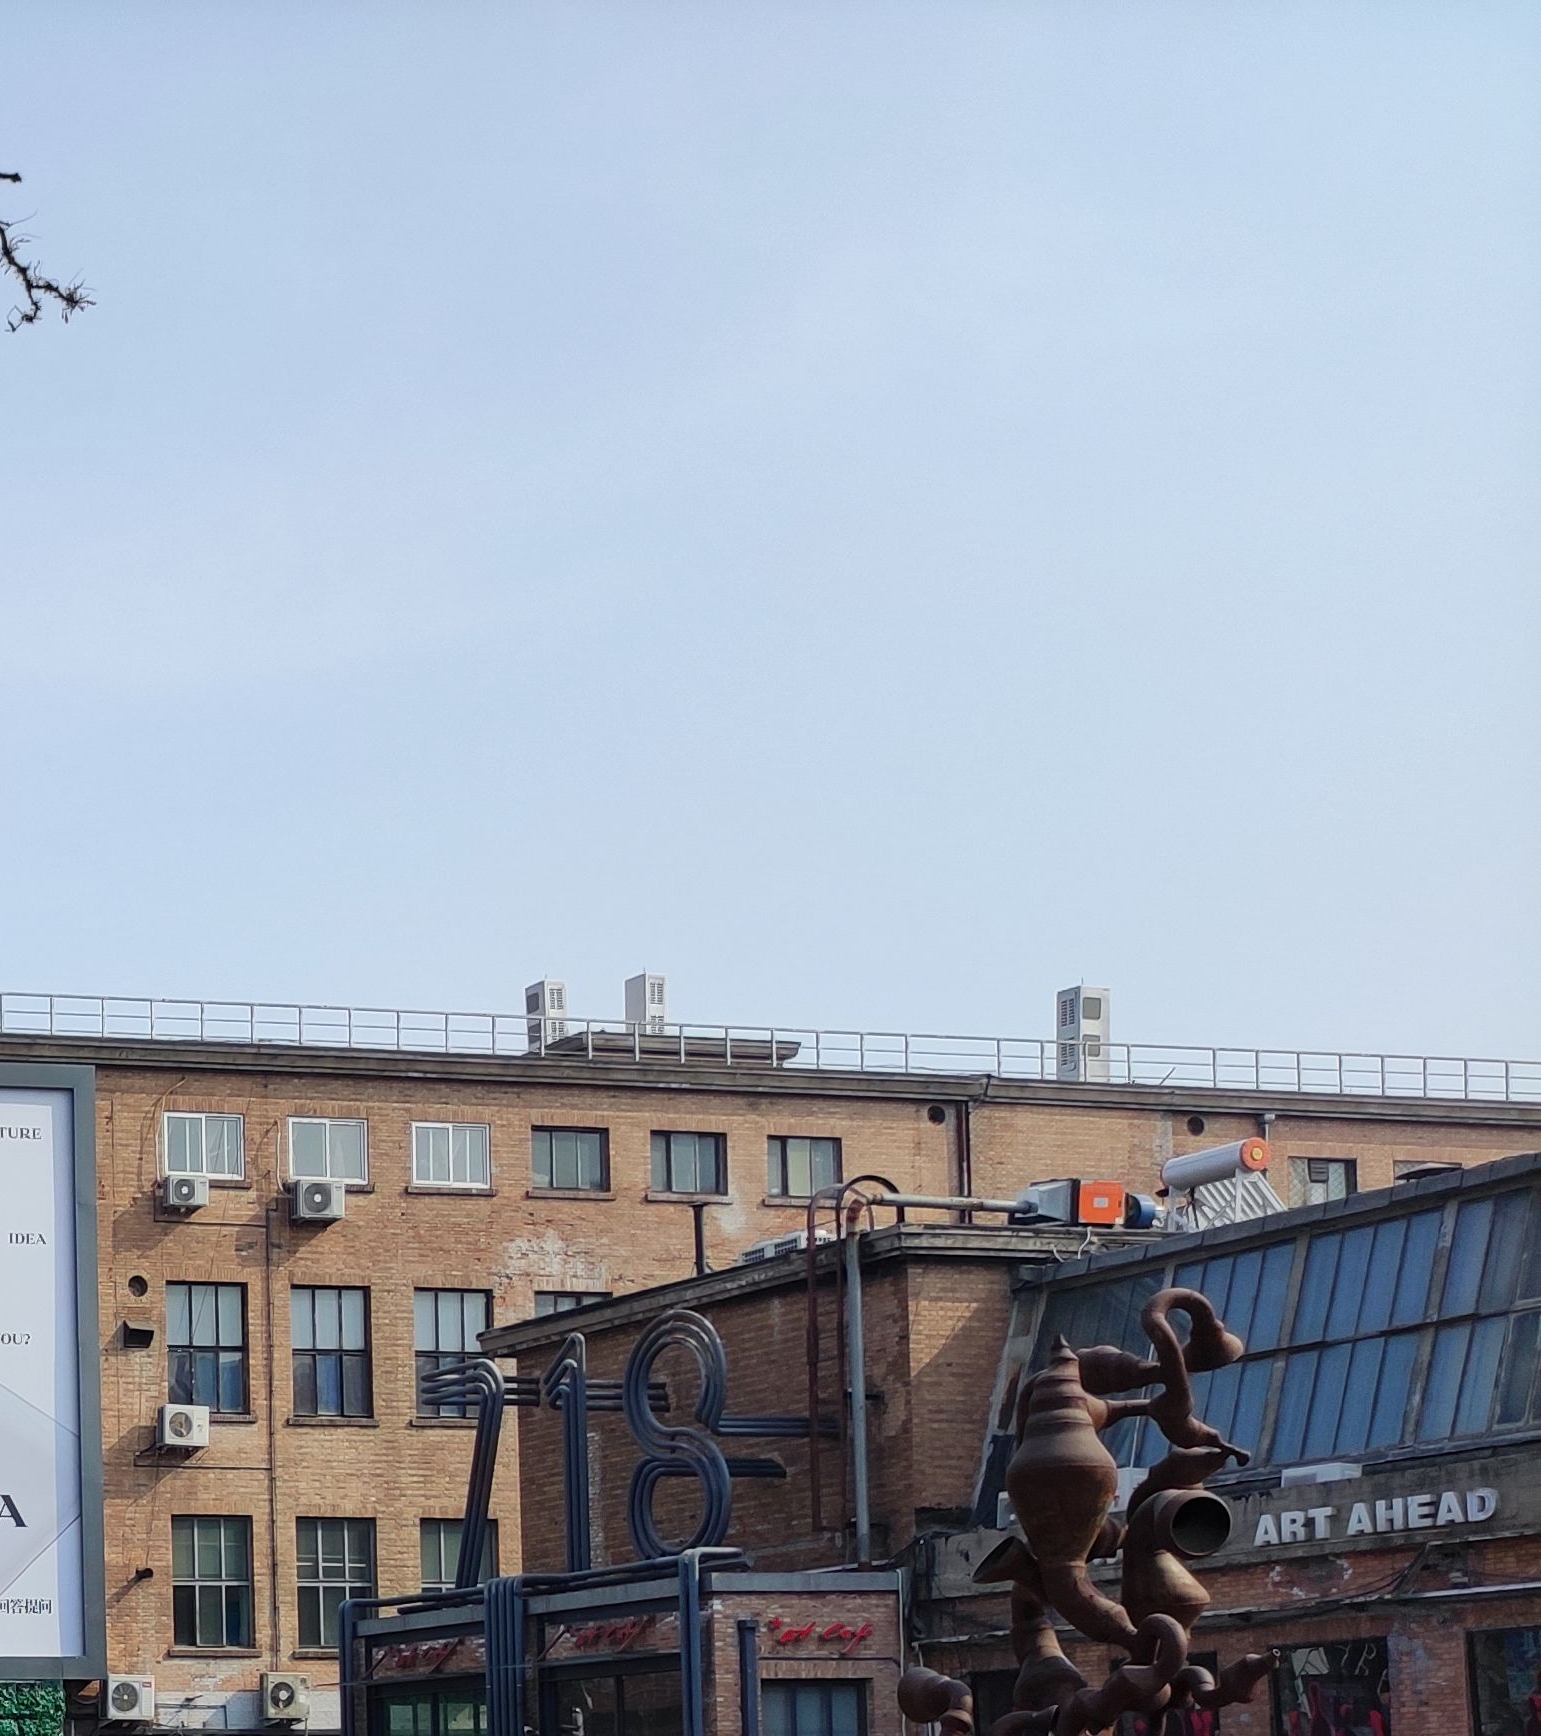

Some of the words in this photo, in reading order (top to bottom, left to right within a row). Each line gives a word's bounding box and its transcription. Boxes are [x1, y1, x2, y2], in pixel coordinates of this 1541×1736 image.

[8, 1232, 47, 1246] IDEA
[1253, 1506, 1334, 1547] ART
[1346, 1486, 1499, 1537] AHEAD
